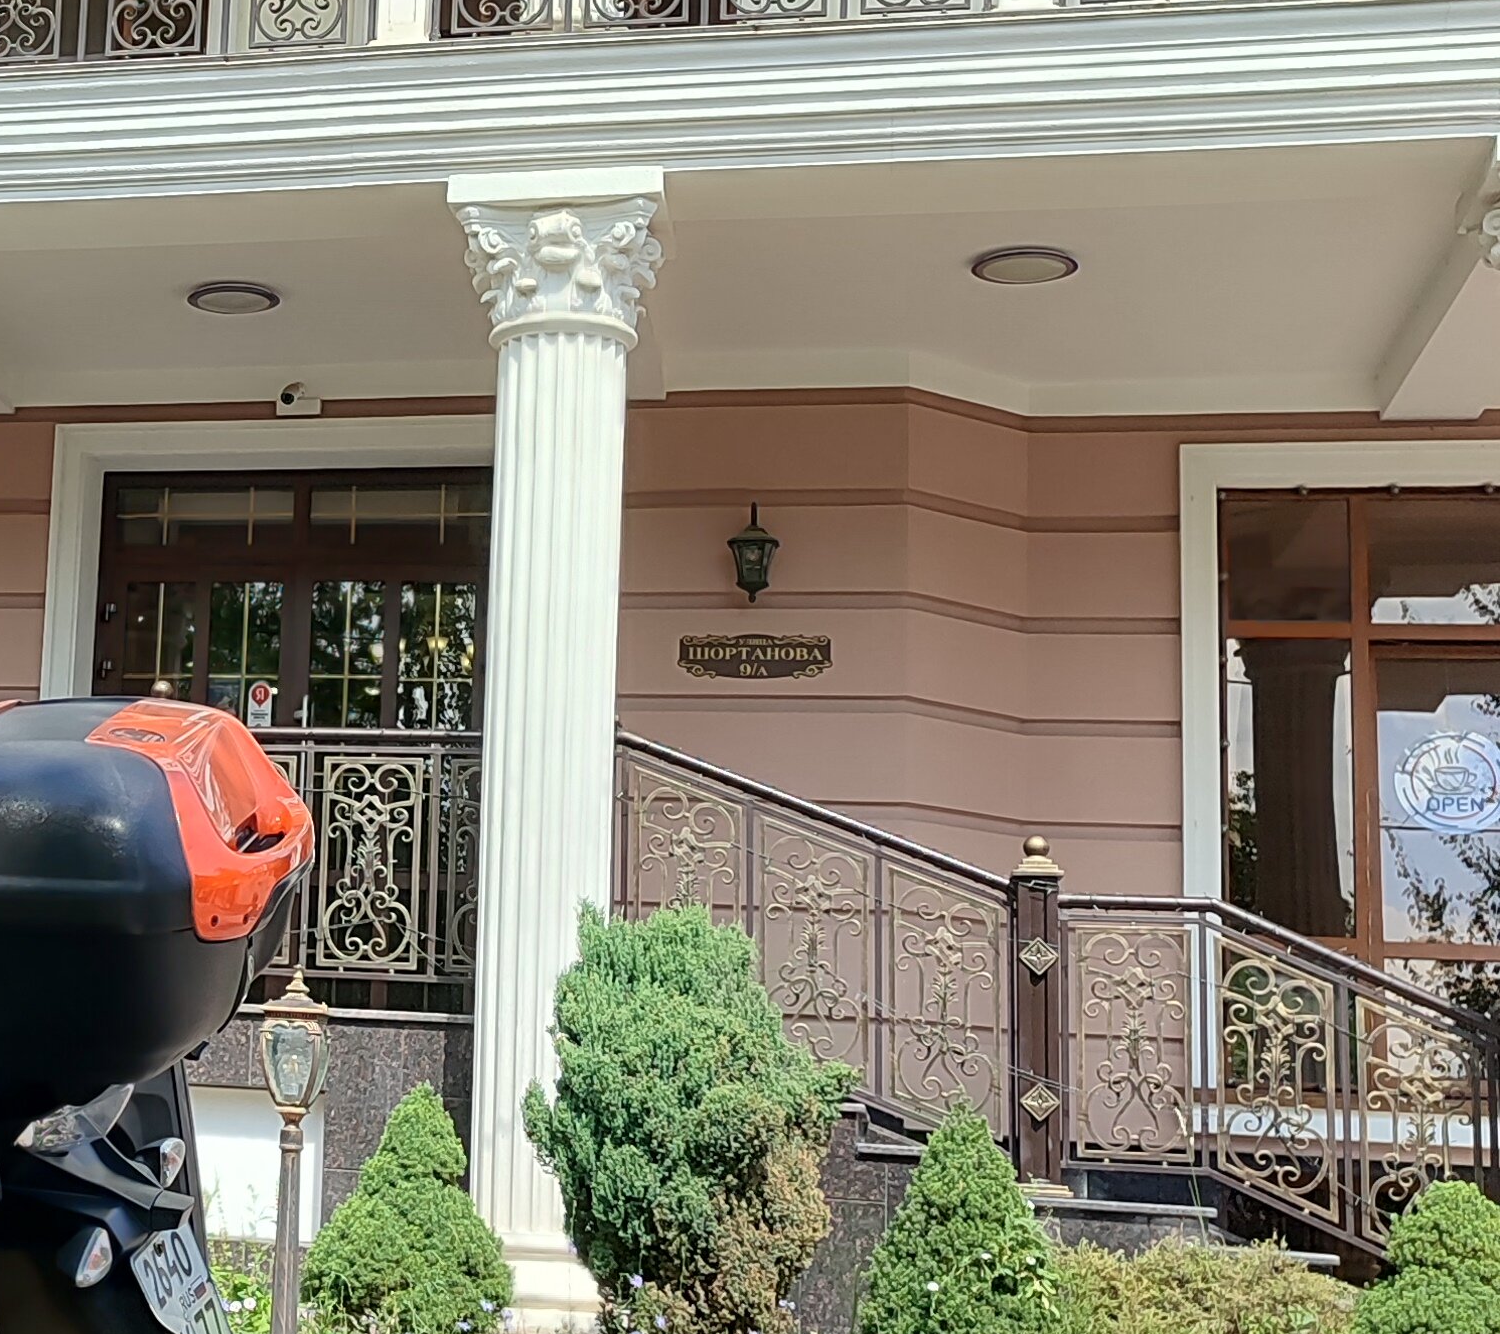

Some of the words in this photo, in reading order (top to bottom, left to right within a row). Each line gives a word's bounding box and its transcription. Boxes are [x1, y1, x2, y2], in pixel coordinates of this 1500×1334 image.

[688, 646, 823, 661] ШОРТАНОВА
[1426, 796, 1485, 813] OPEN
[142, 1231, 193, 1310] 2640
[179, 1287, 196, 1311] RUS
